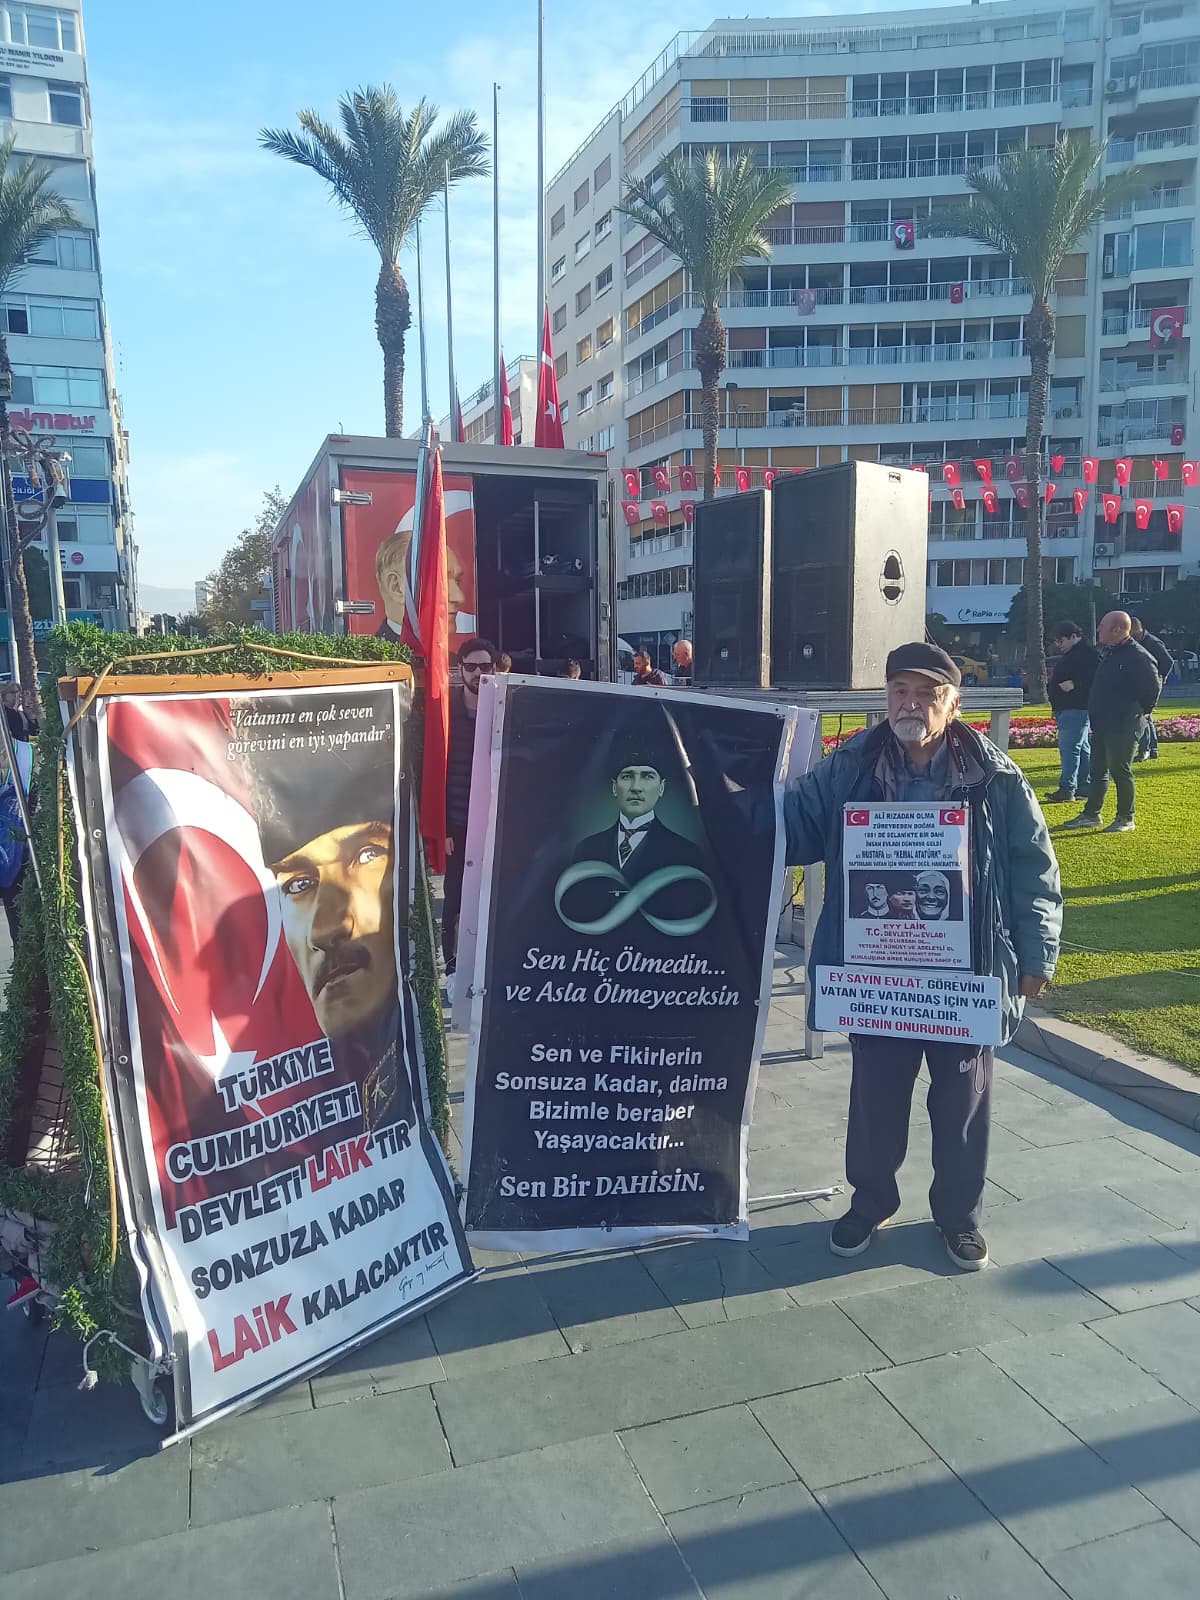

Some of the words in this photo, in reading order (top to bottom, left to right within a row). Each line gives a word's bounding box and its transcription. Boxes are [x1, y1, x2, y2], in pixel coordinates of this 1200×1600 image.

[298, 710, 314, 723] en
[316, 704, 336, 726] çok
[338, 705, 373, 720] seven
[226, 733, 286, 760] görevini
[289, 736, 305, 749] en
[308, 730, 325, 753] iyi
[874, 811, 885, 820] ALİ
[886, 812, 915, 820] RIZADAN
[916, 812, 935, 820] OLMA
[861, 850, 885, 859] MUSTAFA
[866, 928, 884, 937] T.C.
[904, 921, 926, 930] LAİK
[523, 947, 566, 971] Sen
[572, 949, 610, 977] Hiç
[615, 946, 726, 975] Ölmedin...
[505, 983, 530, 1002] ve
[536, 981, 587, 1003] Asla
[594, 978, 739, 1010] Ölmeyeceksin
[829, 972, 843, 982] EY
[846, 973, 882, 985] SAYIN
[927, 978, 985, 994] GÖREVİNİ
[820, 986, 857, 998] VATAN
[860, 988, 875, 999] VE
[878, 991, 941, 1006] VATANDAŞ
[944, 995, 969, 1008] İÇİN
[972, 998, 998, 1010] YAP.
[850, 1001, 888, 1015] GÖREV
[891, 1006, 962, 1022] KUTSALDIR.
[839, 1016, 853, 1027] BU
[857, 1018, 892, 1030] SENİN
[895, 1021, 973, 1038] ONURUNDUR.
[530, 1044, 572, 1063] Sen
[579, 1047, 603, 1063] ve
[609, 1045, 703, 1066] Fikirlerin
[218, 1040, 333, 1108] TÜRKİYE
[494, 1072, 587, 1091] Sonsuza
[593, 1073, 663, 1097] Kadar,
[669, 1075, 728, 1094] daima
[529, 1100, 609, 1121] Bizimle
[616, 1103, 695, 1122] beraber
[168, 1086, 361, 1179] CUMHURİYETİ
[534, 1130, 684, 1153] Yaşayacaktır...
[499, 1175, 546, 1198] Sen
[551, 1173, 590, 1198] Bir
[191, 1220, 329, 1300] SONZUZA
[329, 1178, 406, 1240] KADAR
[207, 1293, 298, 1373] LAİK
[303, 1222, 449, 1325] KALACAKTIR
